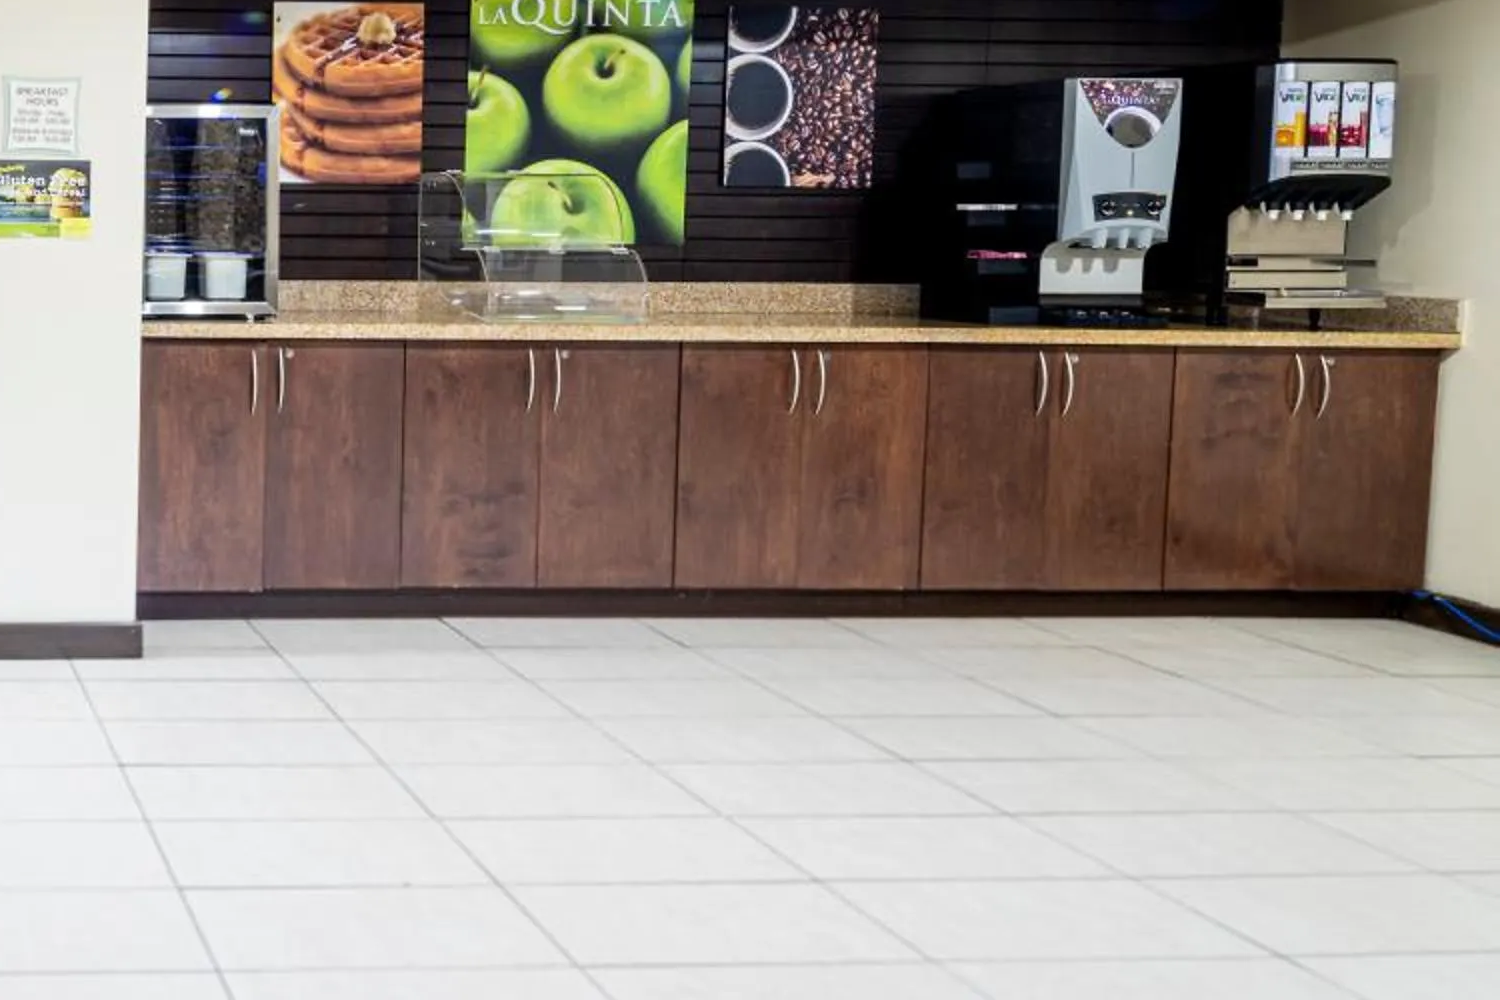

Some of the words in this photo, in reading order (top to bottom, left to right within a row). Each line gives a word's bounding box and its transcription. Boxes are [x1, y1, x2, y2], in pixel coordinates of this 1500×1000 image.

[477, 6, 508, 25] LA
[16, 87, 69, 98] BREAKFAST
[26, 97, 60, 107] HOURS
